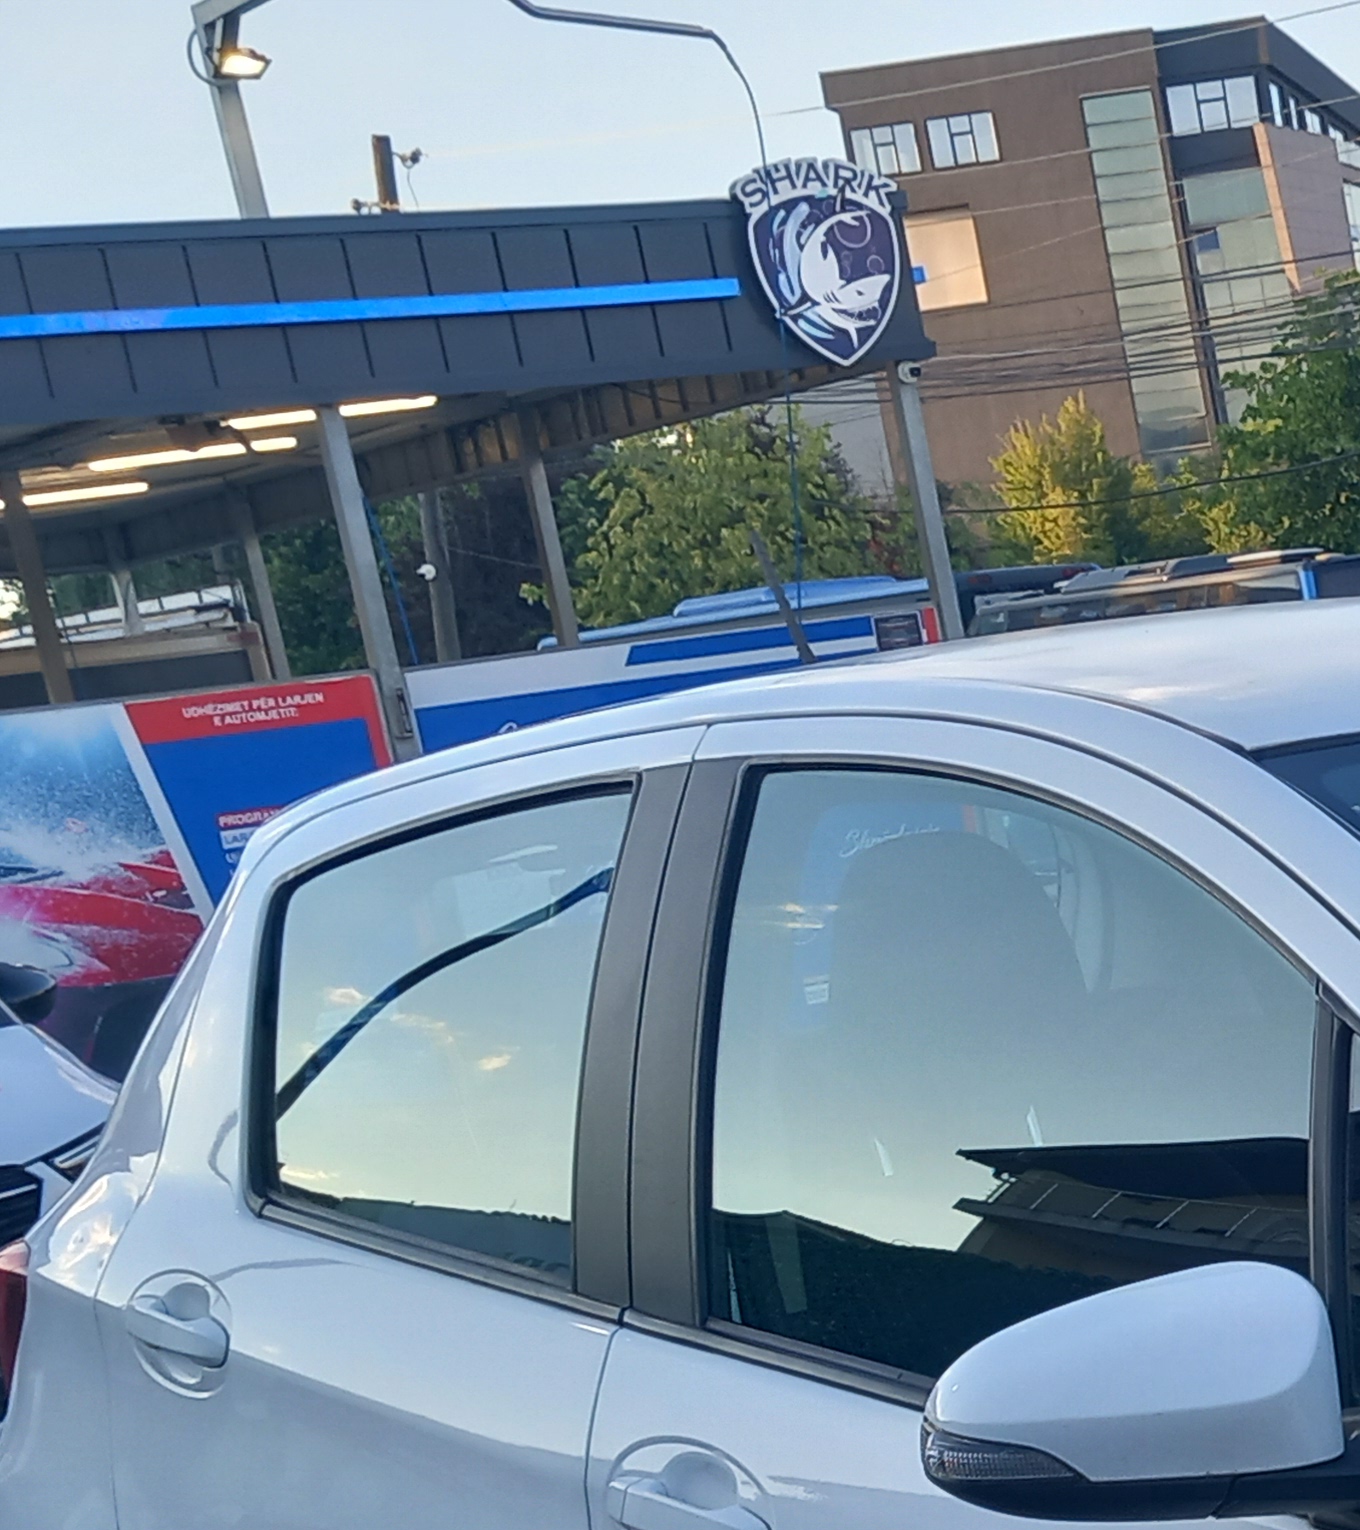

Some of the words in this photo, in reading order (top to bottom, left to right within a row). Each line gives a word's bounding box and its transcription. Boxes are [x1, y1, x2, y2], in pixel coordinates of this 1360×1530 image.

[740, 162, 891, 210] SHARK
[279, 692, 325, 708] LARJEN
[213, 715, 222, 726] E
